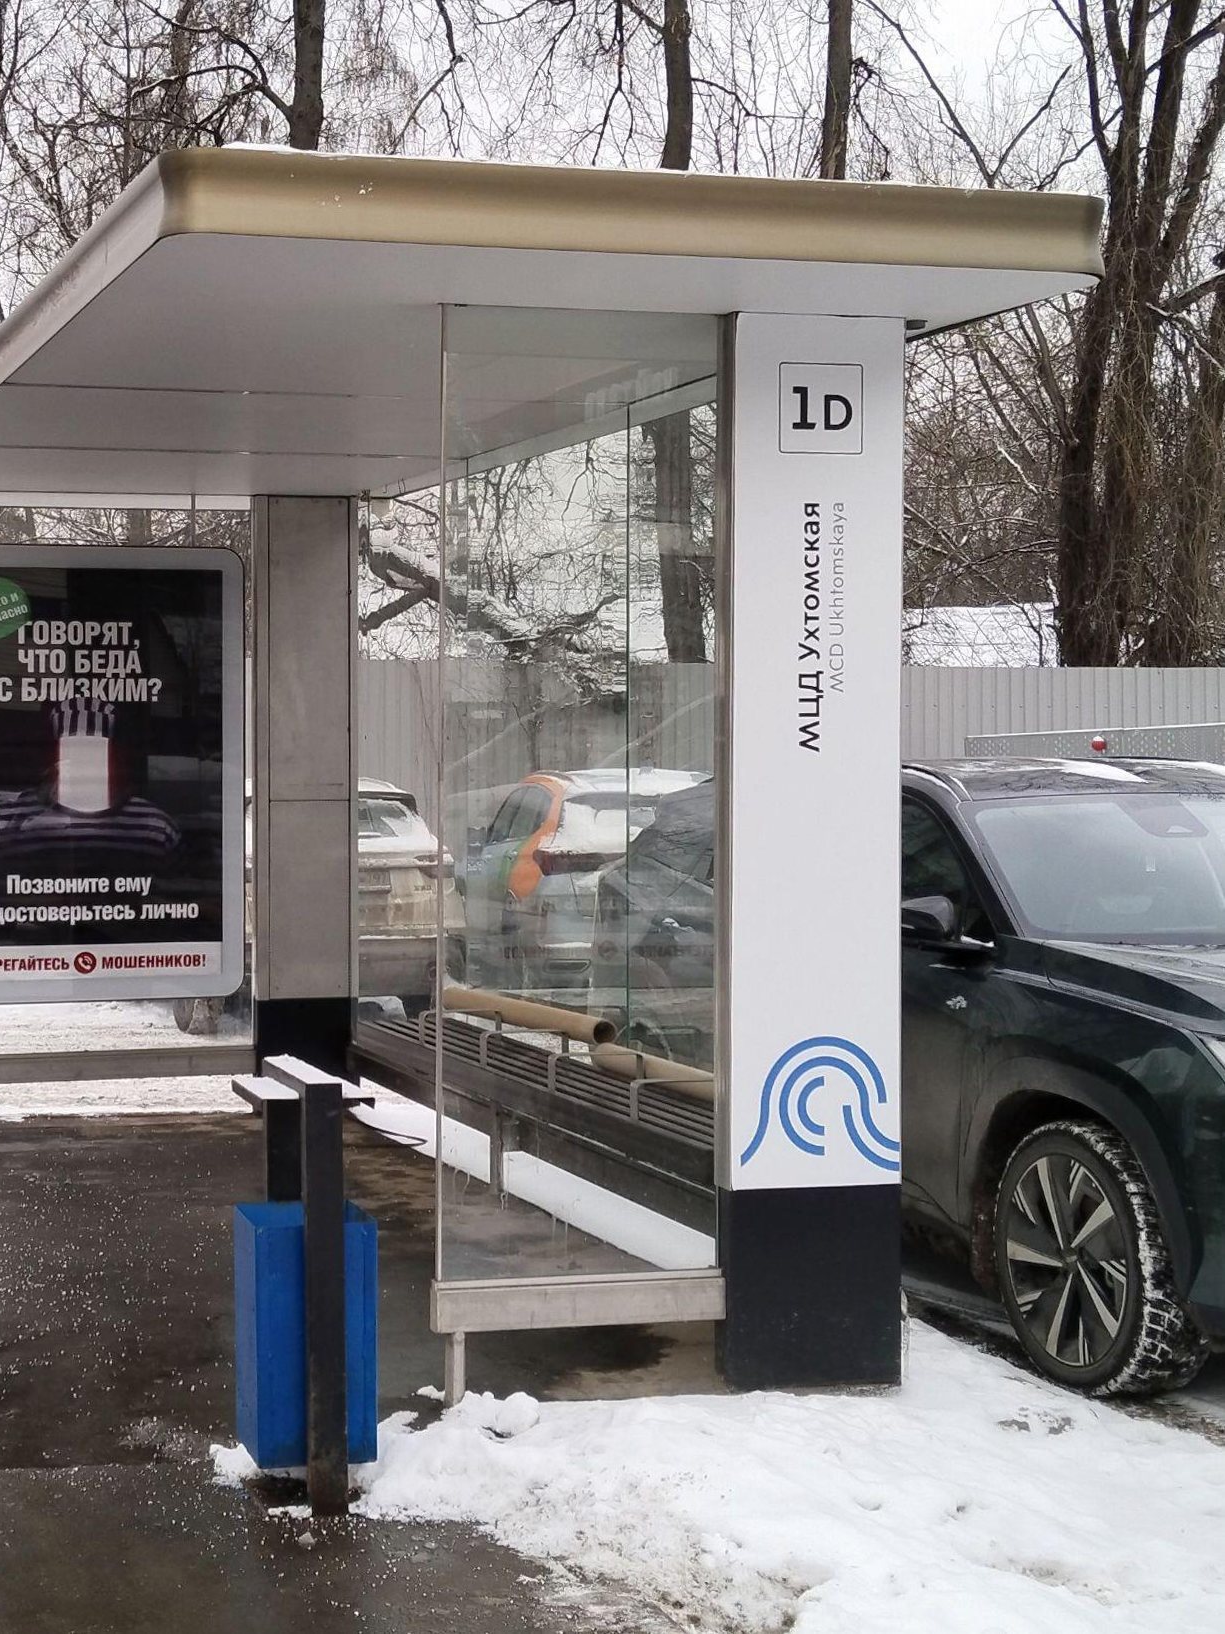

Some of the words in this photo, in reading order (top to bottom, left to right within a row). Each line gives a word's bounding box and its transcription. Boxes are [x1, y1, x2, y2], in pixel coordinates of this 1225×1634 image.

[792, 386, 853, 430] 1D
[798, 502, 821, 661] Ухтомская
[828, 502, 847, 637] Ukhtomskaya
[10, 592, 19, 603] и
[17, 620, 140, 650] ГОВОРЯТ,
[17, 648, 67, 674] ЧТО
[74, 649, 142, 679] БЕДА
[828, 643, 845, 693] MCD
[21, 677, 163, 702] БЛИЗКИМ?
[798, 670, 824, 753] МЦД
[7, 874, 110, 895] Позвоните
[114, 877, 152, 896] ему
[140, 902, 199, 921] лично
[101, 954, 206, 970] МОШЕННИКОВ!
